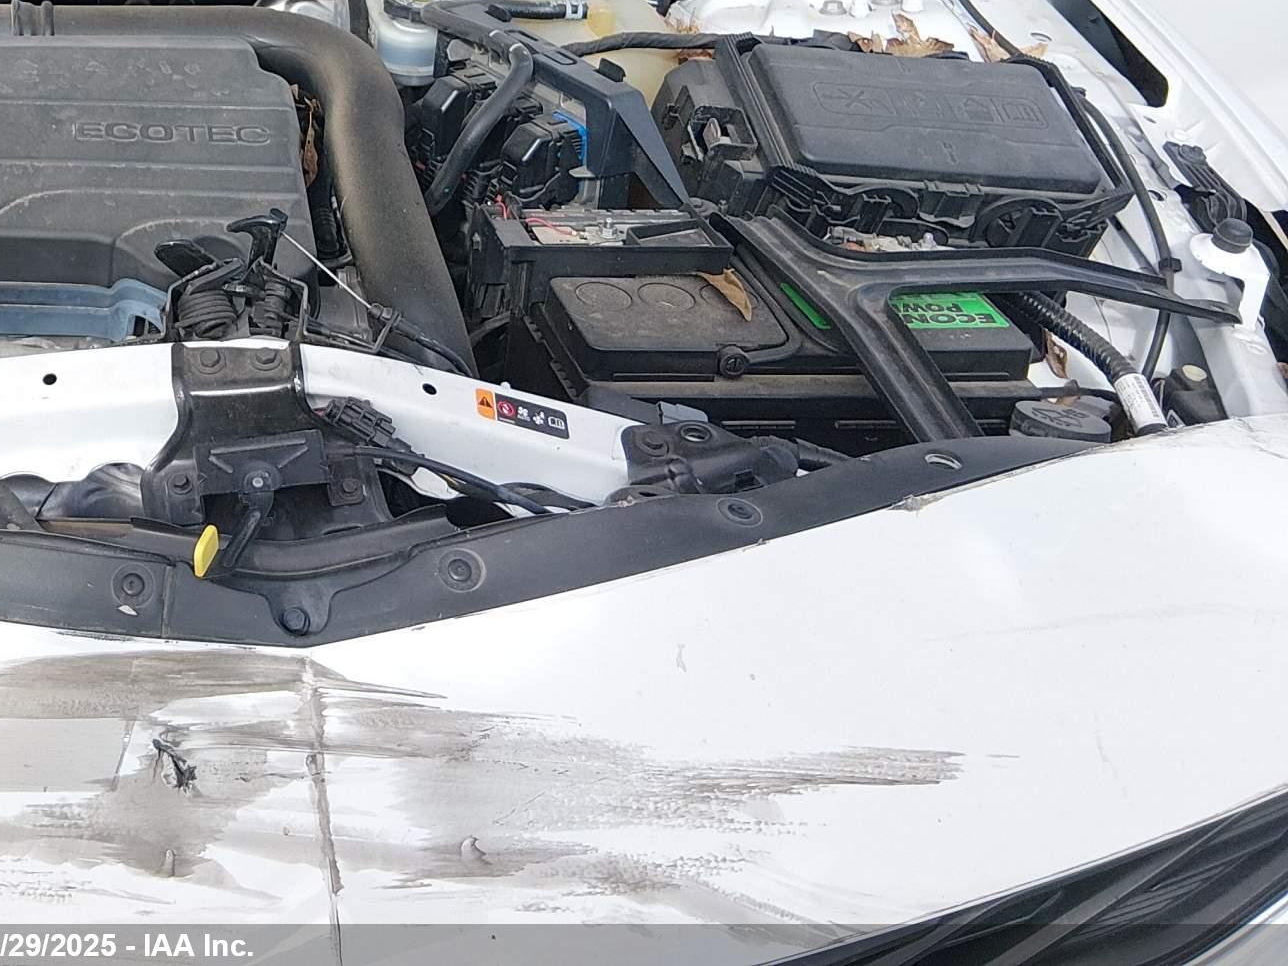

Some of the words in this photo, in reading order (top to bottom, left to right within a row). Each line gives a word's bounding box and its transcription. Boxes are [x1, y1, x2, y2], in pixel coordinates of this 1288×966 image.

[73, 121, 271, 146] ECOTEC
[895, 303, 965, 313] POW
[903, 313, 998, 324] ECON
